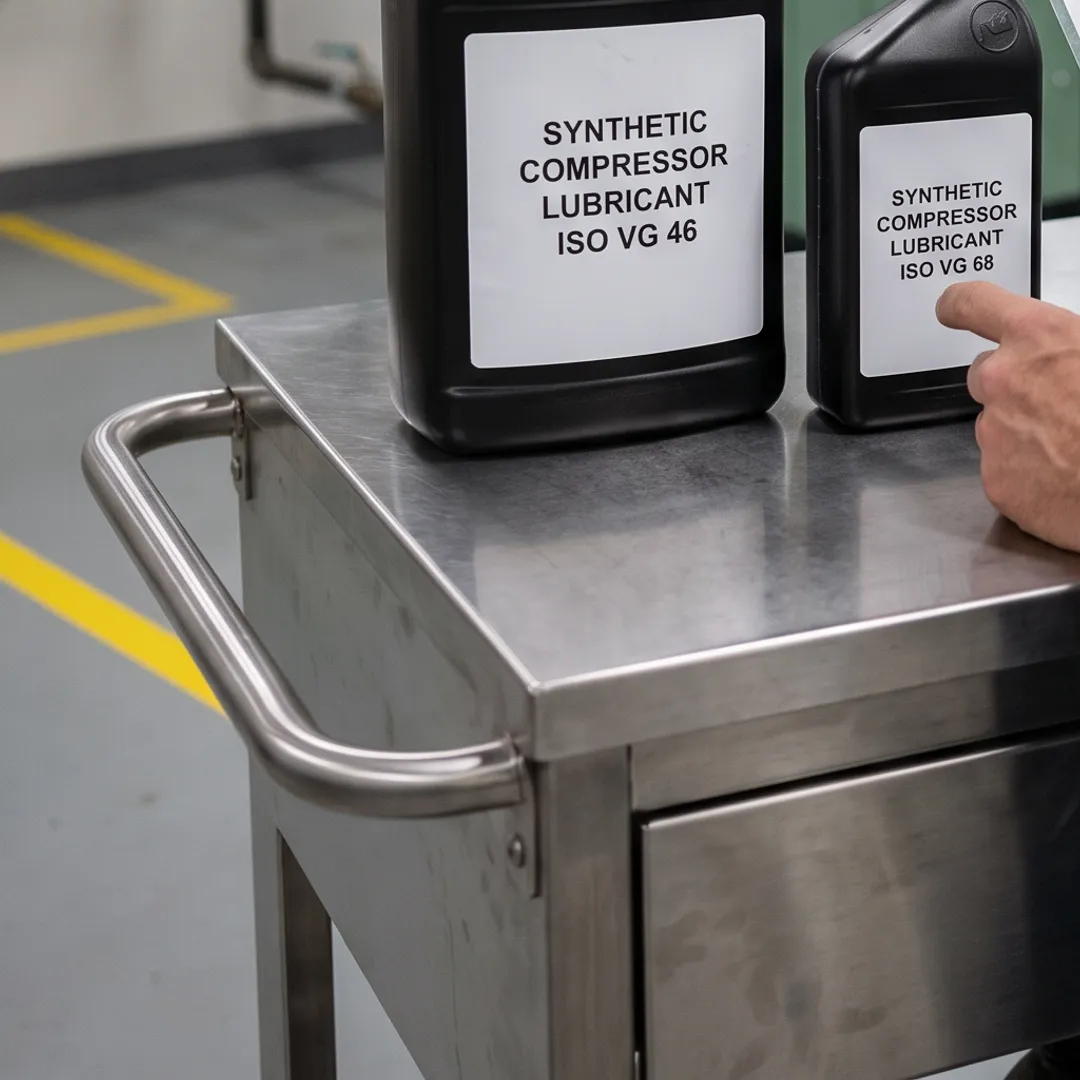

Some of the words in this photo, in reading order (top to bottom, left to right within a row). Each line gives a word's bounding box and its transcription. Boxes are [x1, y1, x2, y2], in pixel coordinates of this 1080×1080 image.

[543, 109, 707, 146] SYNTHETIC
[519, 143, 729, 184] COMPRESSOR
[542, 180, 710, 220] LUBRICANT
[891, 180, 1003, 207] SYNTHETIC
[876, 203, 1018, 233] COMPRESSOR
[558, 228, 609, 256] ISO
[617, 223, 658, 250] VG
[666, 218, 698, 244] 46
[890, 228, 1004, 257] LUBRICANT
[900, 261, 934, 281] ISO
[939, 257, 967, 276] VG
[973, 254, 994, 272] 68
